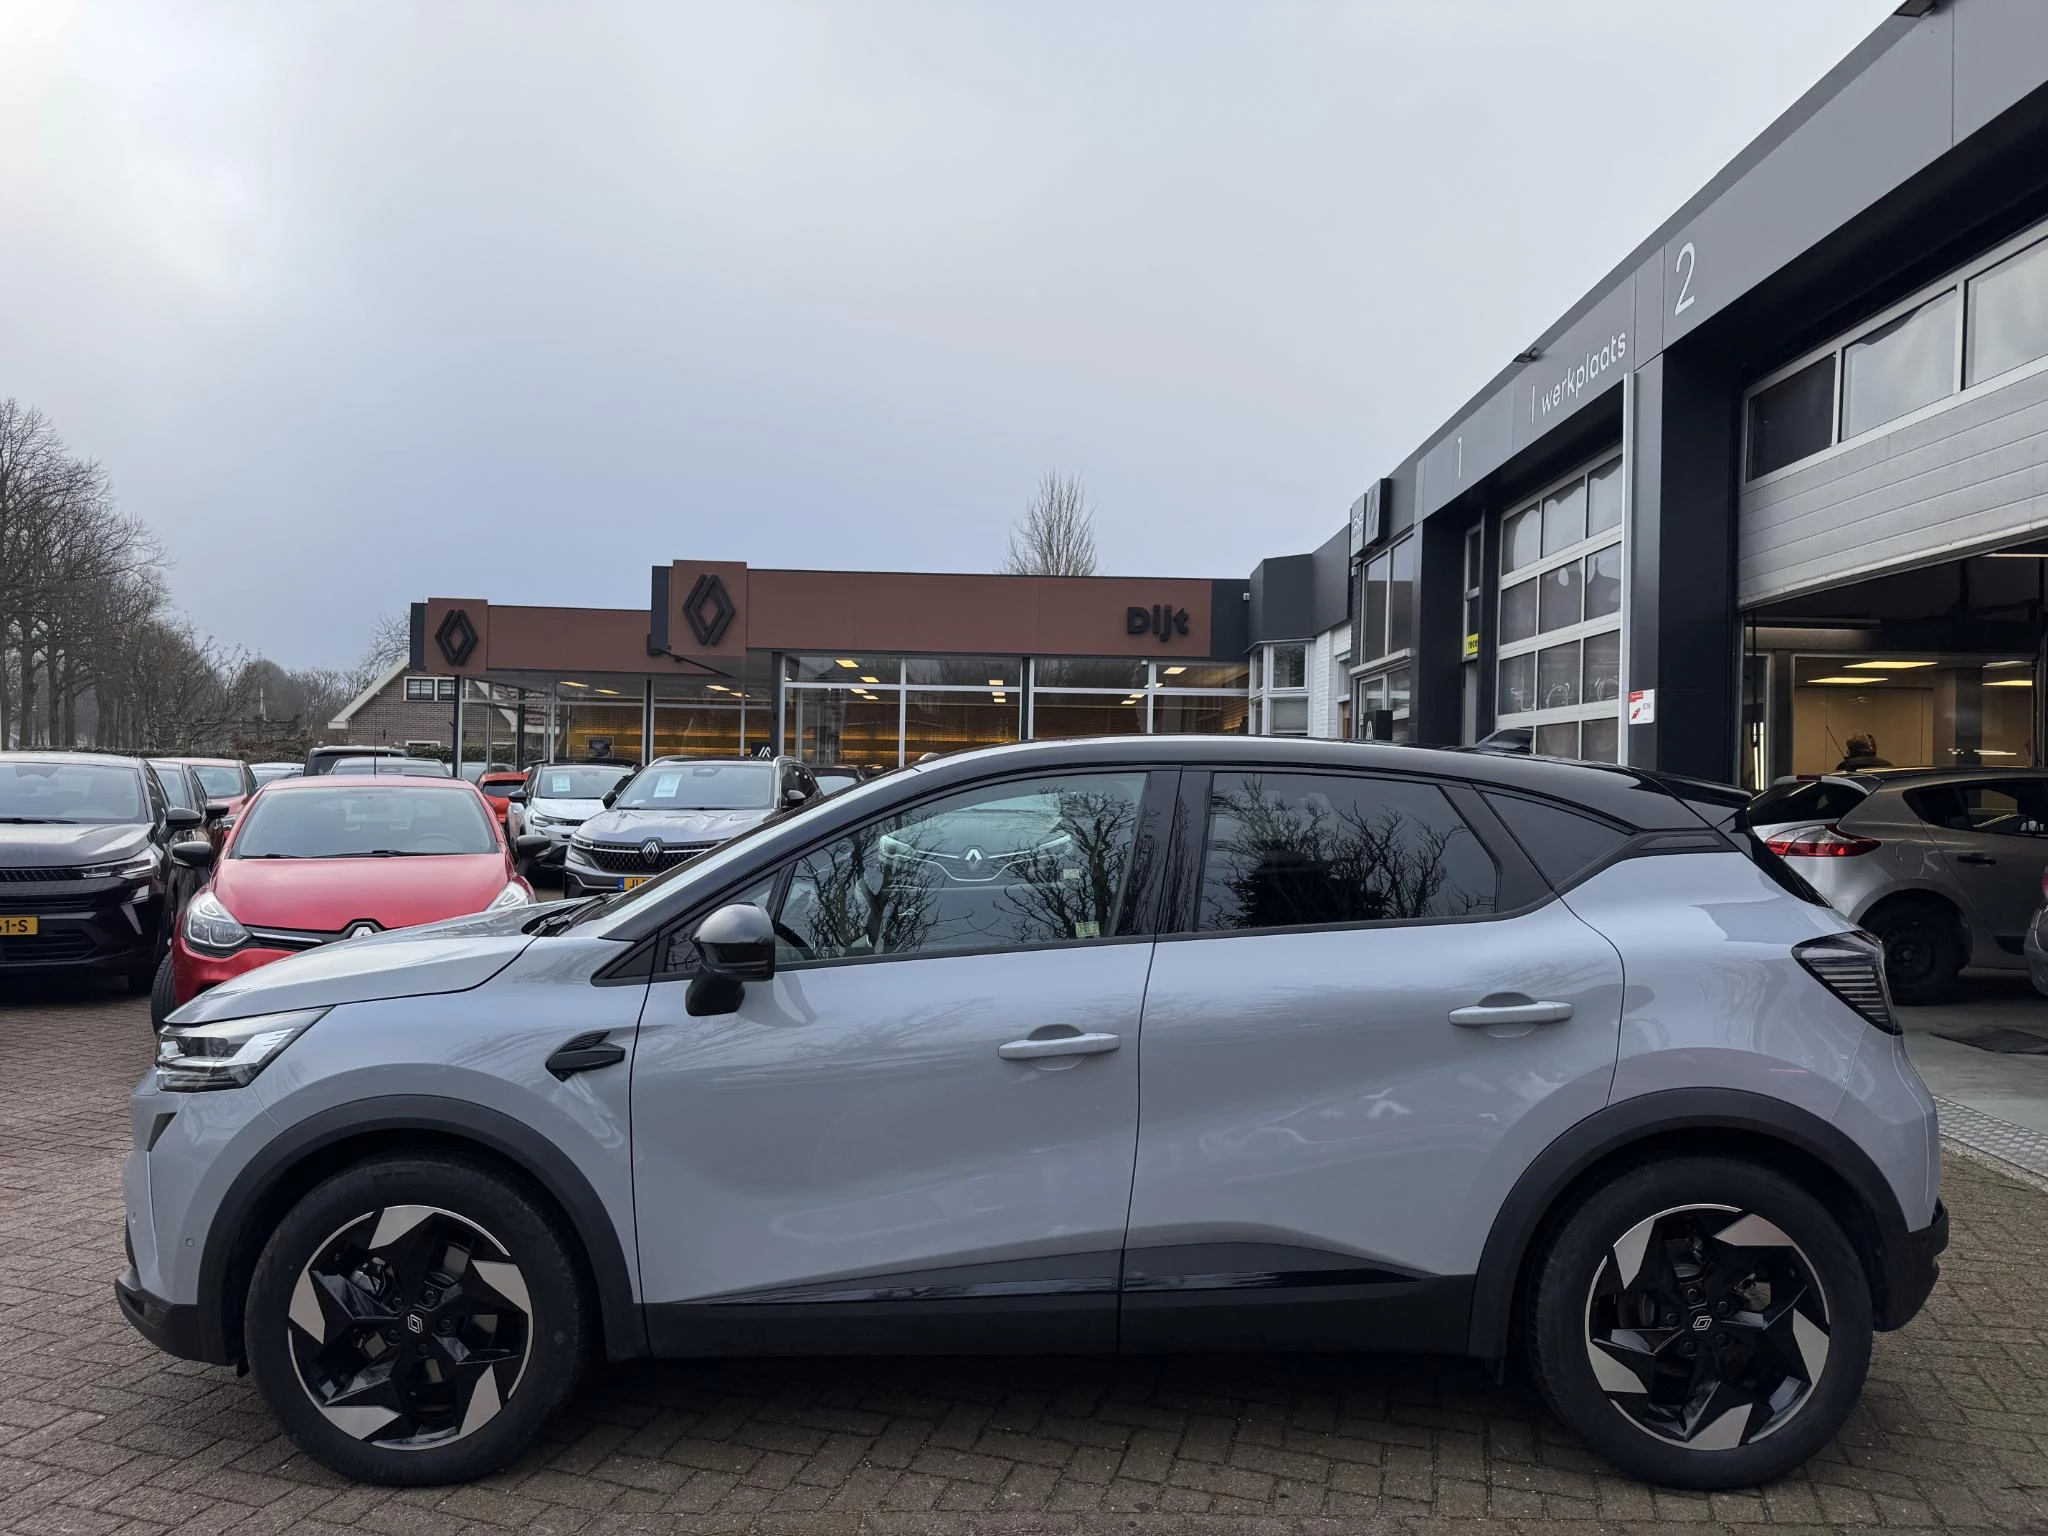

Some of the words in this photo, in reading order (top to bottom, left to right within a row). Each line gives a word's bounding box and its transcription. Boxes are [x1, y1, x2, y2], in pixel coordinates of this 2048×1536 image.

[1675, 242, 1695, 316] 2
[1541, 332, 1626, 416] werkplaats
[1457, 436, 1463, 479] 1
[1127, 604, 1189, 642] Dijt
[0, 919, 28, 933] 1-S
